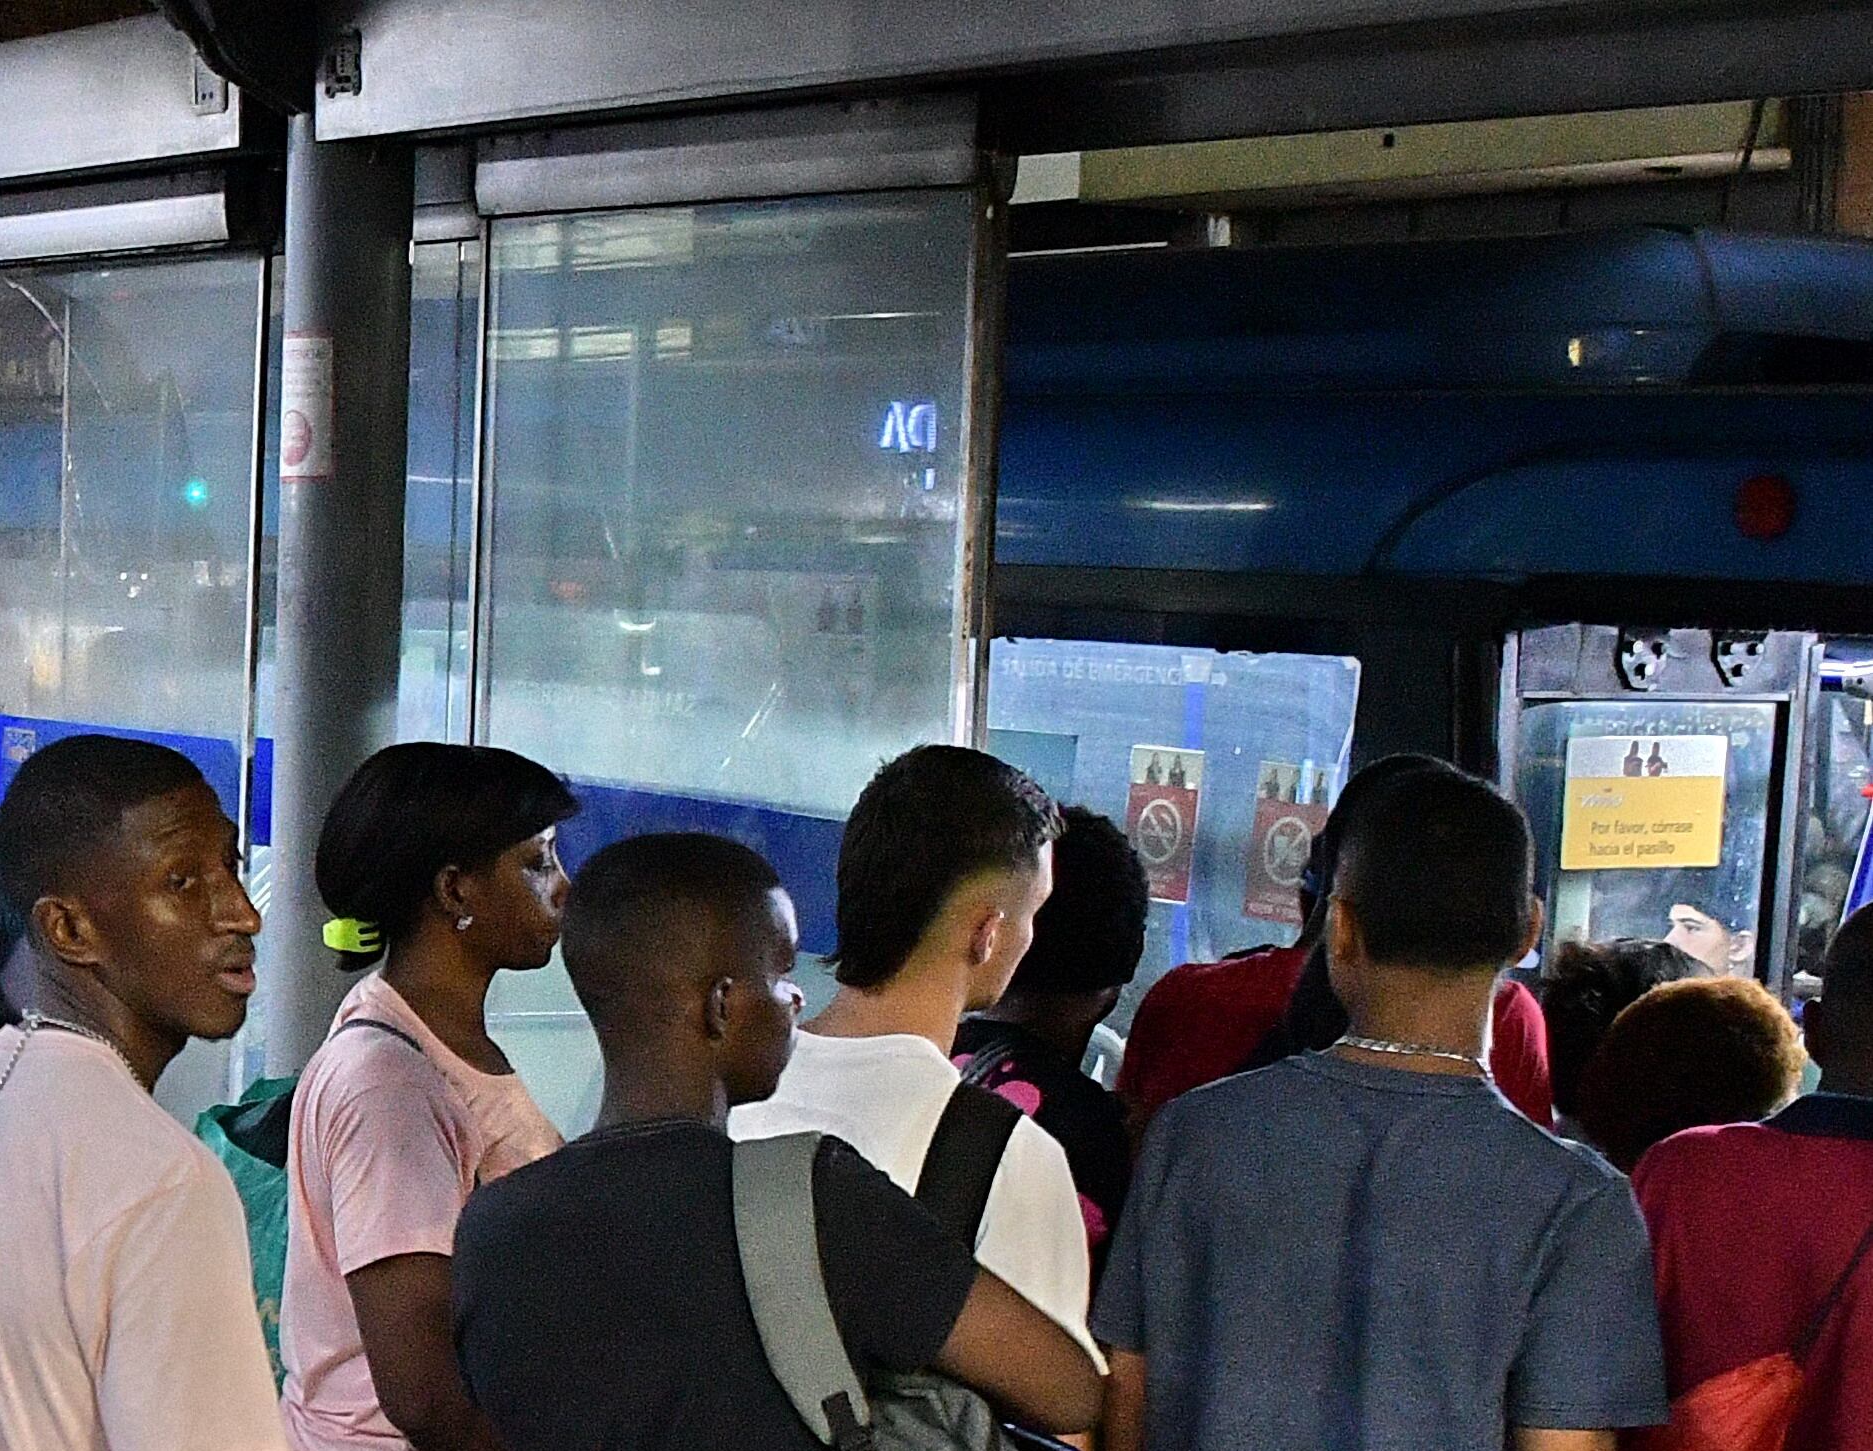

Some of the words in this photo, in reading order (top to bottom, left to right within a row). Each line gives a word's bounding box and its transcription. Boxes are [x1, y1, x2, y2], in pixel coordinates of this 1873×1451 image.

[1088, 662, 1182, 687] EMERGENC
[1590, 821, 1610, 835] Por
[1614, 820, 1648, 836] favor,
[1589, 842, 1620, 857] hacia
[1623, 842, 1635, 856] el
[1637, 840, 1676, 858] pasillo
